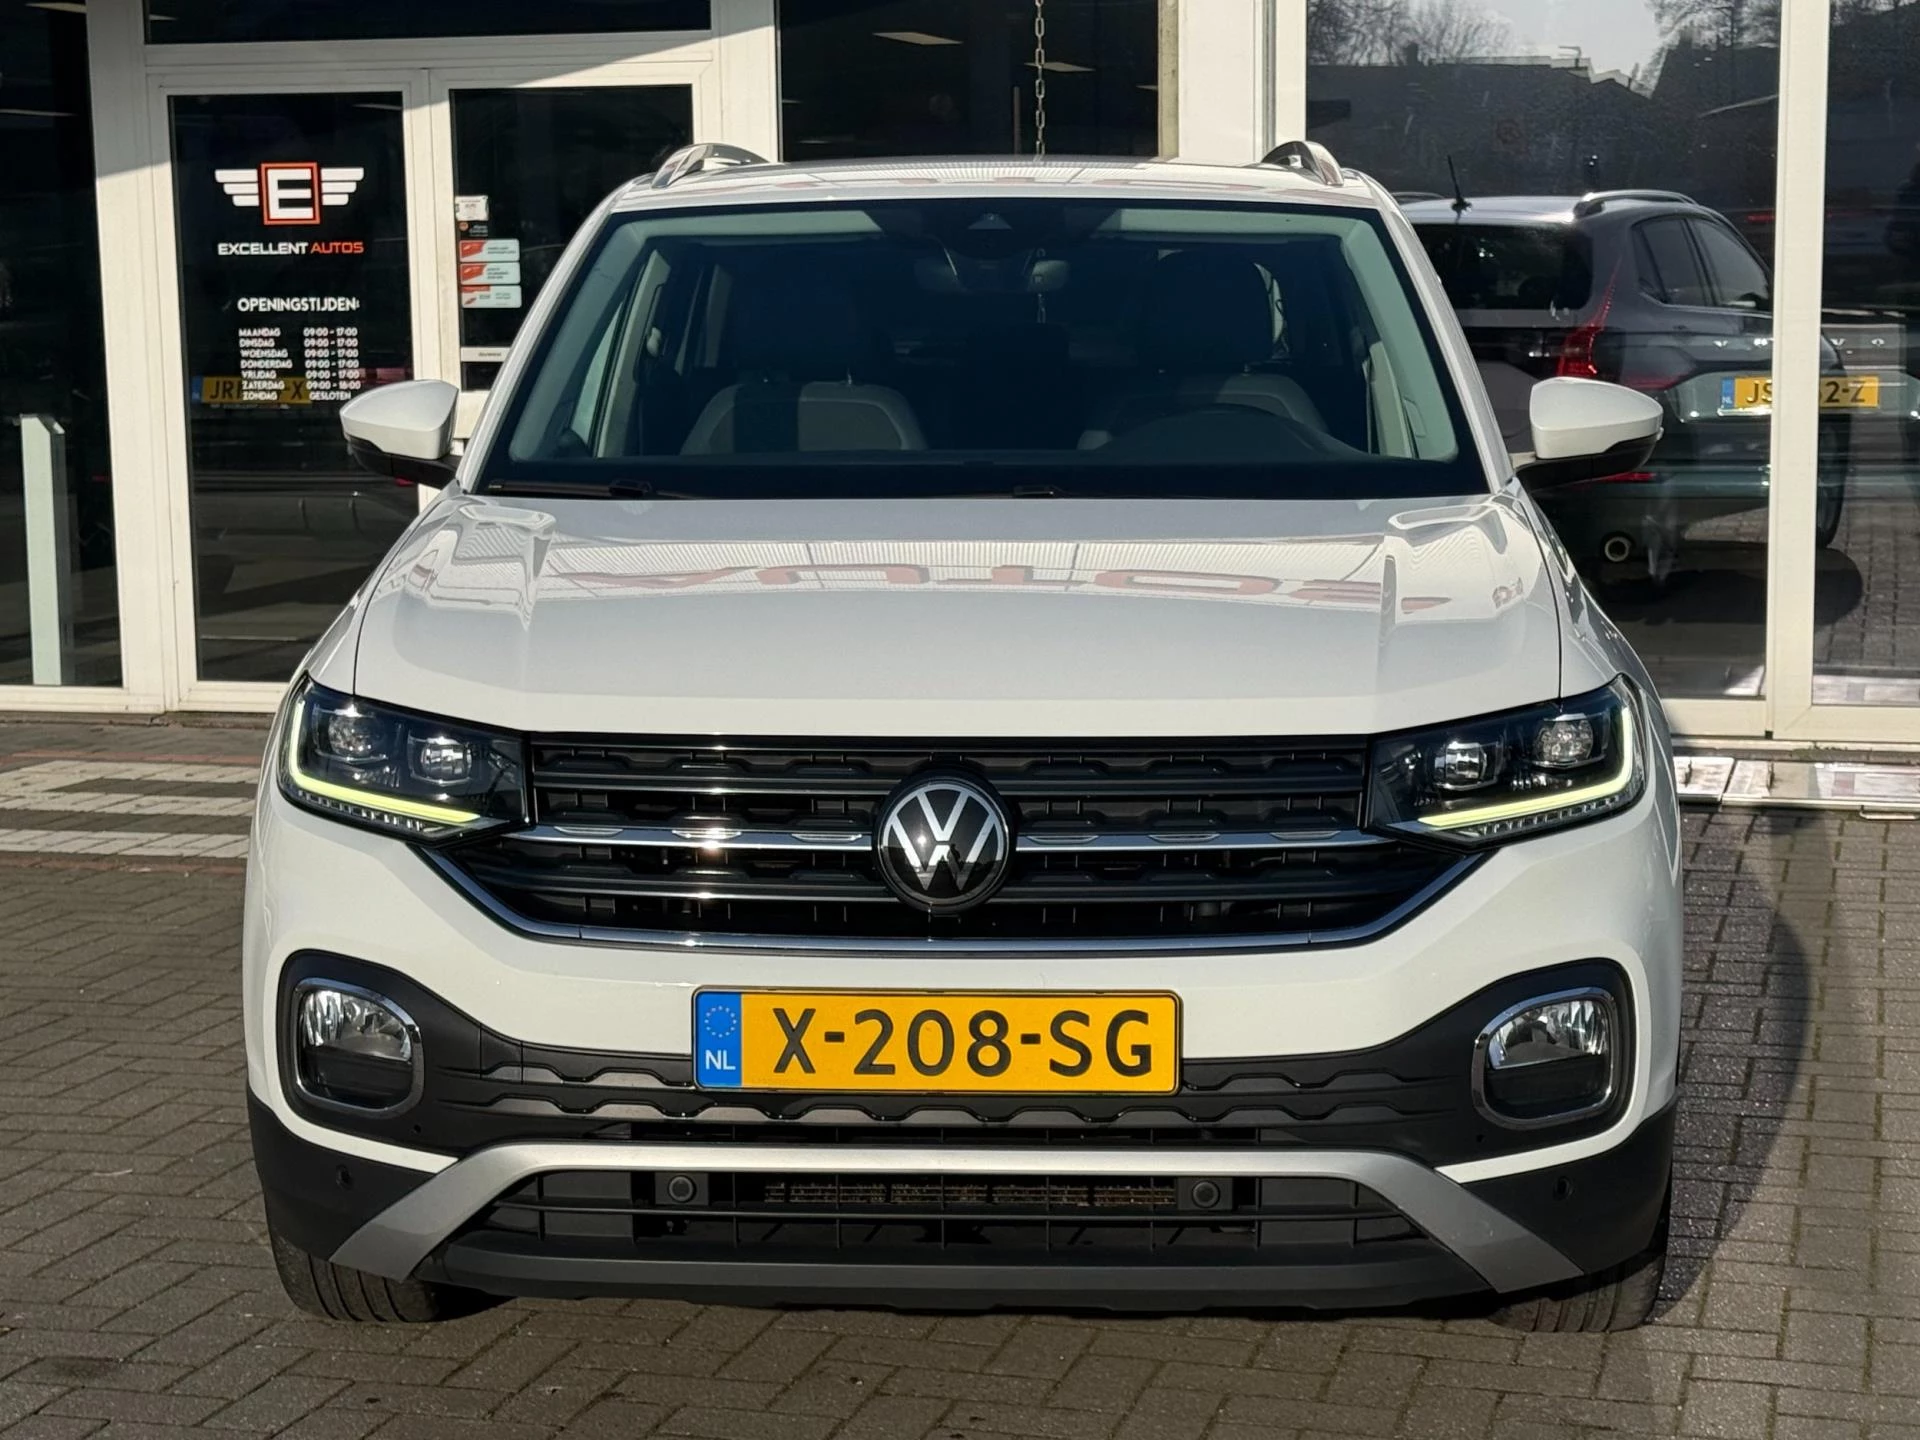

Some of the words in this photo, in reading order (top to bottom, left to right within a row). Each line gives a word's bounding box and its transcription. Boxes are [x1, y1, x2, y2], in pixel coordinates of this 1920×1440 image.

[218, 242, 309, 256] EXCELLENT
[310, 241, 365, 254] AUTOS
[237, 297, 360, 312] OPENINGSTIJDEN:
[239, 327, 281, 337] MAANDAG
[239, 338, 275, 348] DINSDAG
[240, 348, 288, 358] WOENSDAG
[240, 359, 293, 368] DONDERDAG
[241, 370, 277, 379] VRIJDAG
[242, 380, 285, 390] ZATERDAG
[243, 391, 278, 400] ZONDAG
[309, 391, 352, 400] GESLOTEN
[772, 1008, 1152, 1078] X-208-SG
[705, 1050, 736, 1071] NL
